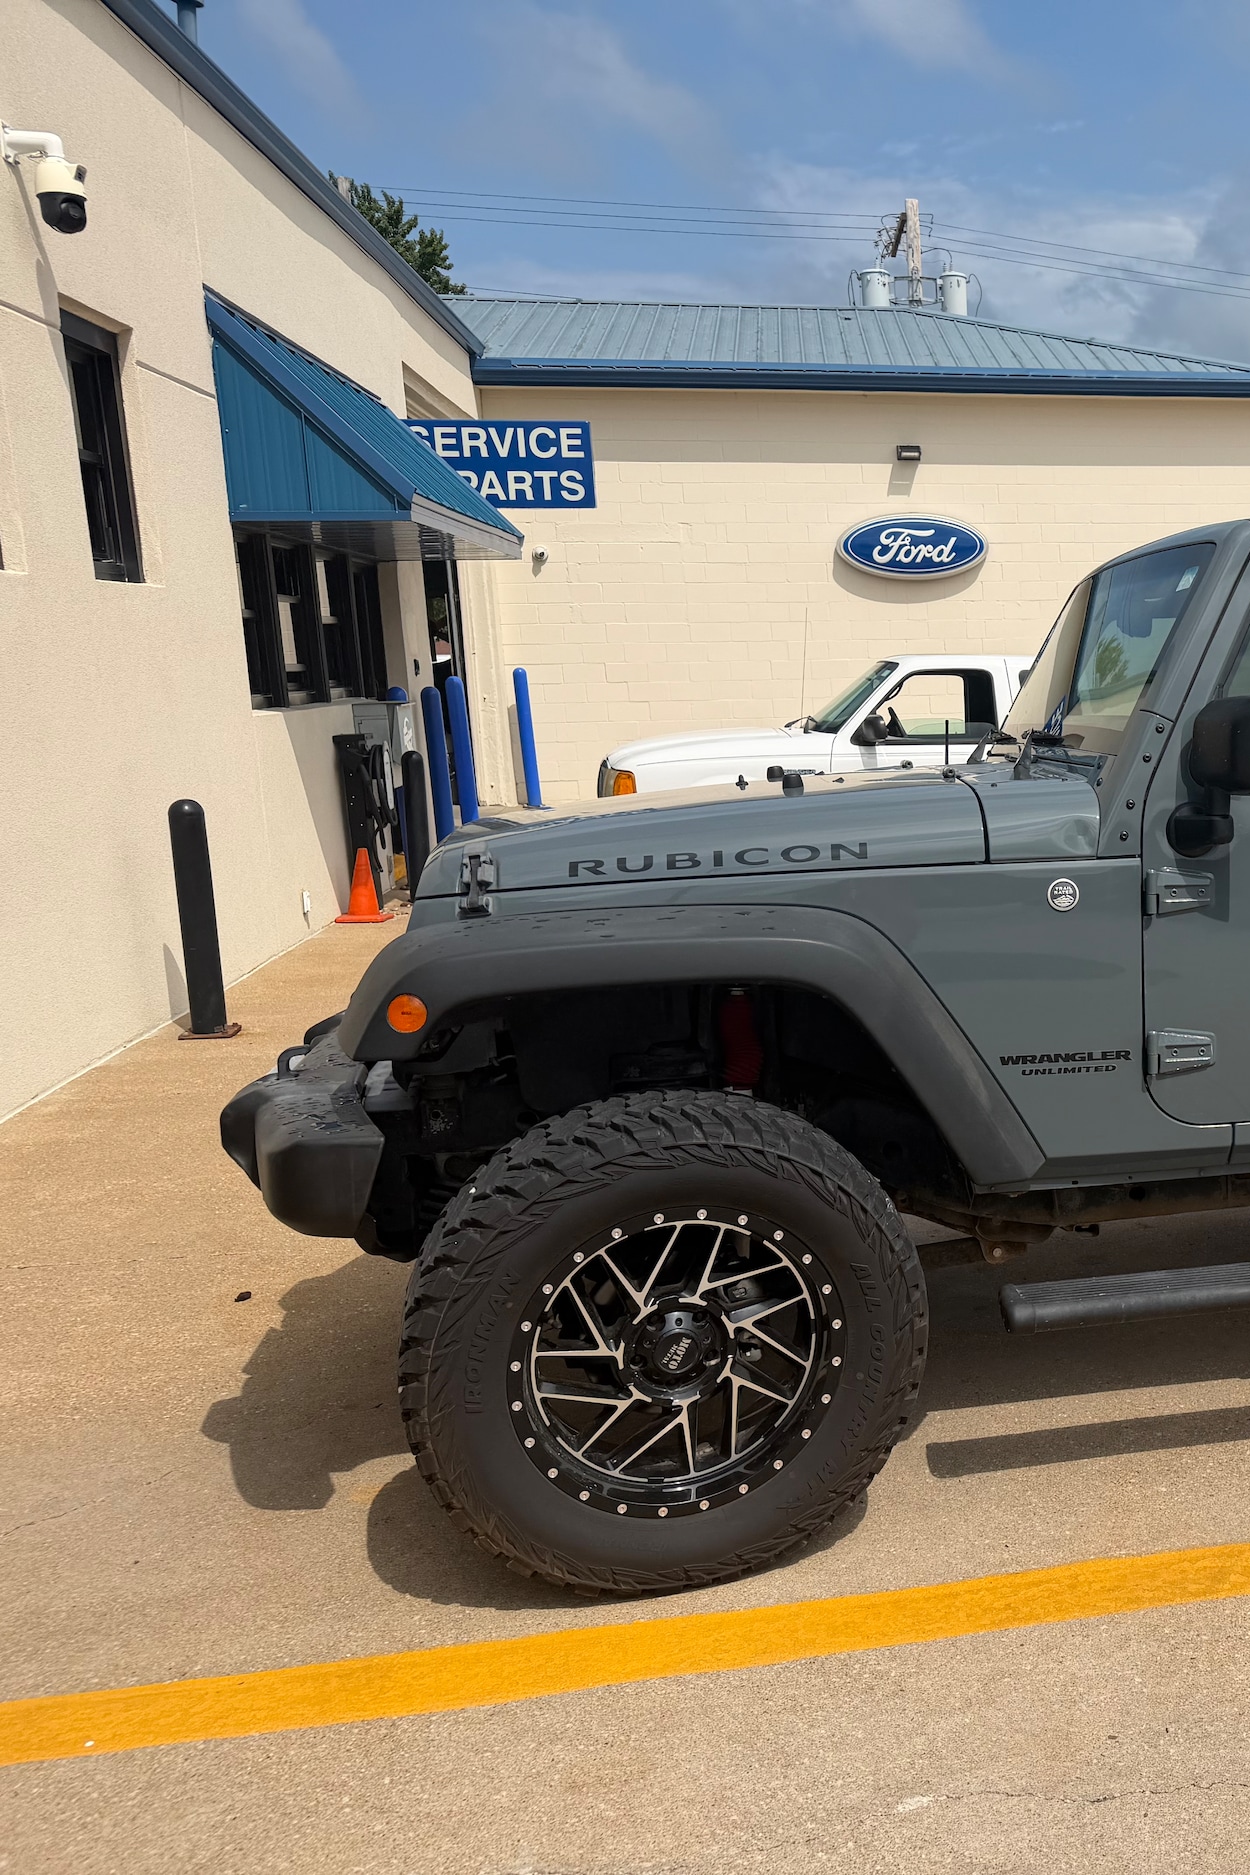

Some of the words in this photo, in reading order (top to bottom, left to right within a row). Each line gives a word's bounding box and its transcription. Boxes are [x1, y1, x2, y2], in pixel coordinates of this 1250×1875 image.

[872, 527, 957, 564] Ford
[568, 842, 868, 878] RUBICON
[1000, 1050, 1133, 1066] WRANGLER
[1021, 1065, 1118, 1076] UNLIMITED
[850, 1261, 882, 1314] ALL
[463, 1267, 521, 1415] IRONMAN
[668, 1336, 692, 1370] MOTO
[838, 1322, 886, 1458] COUNTRY
